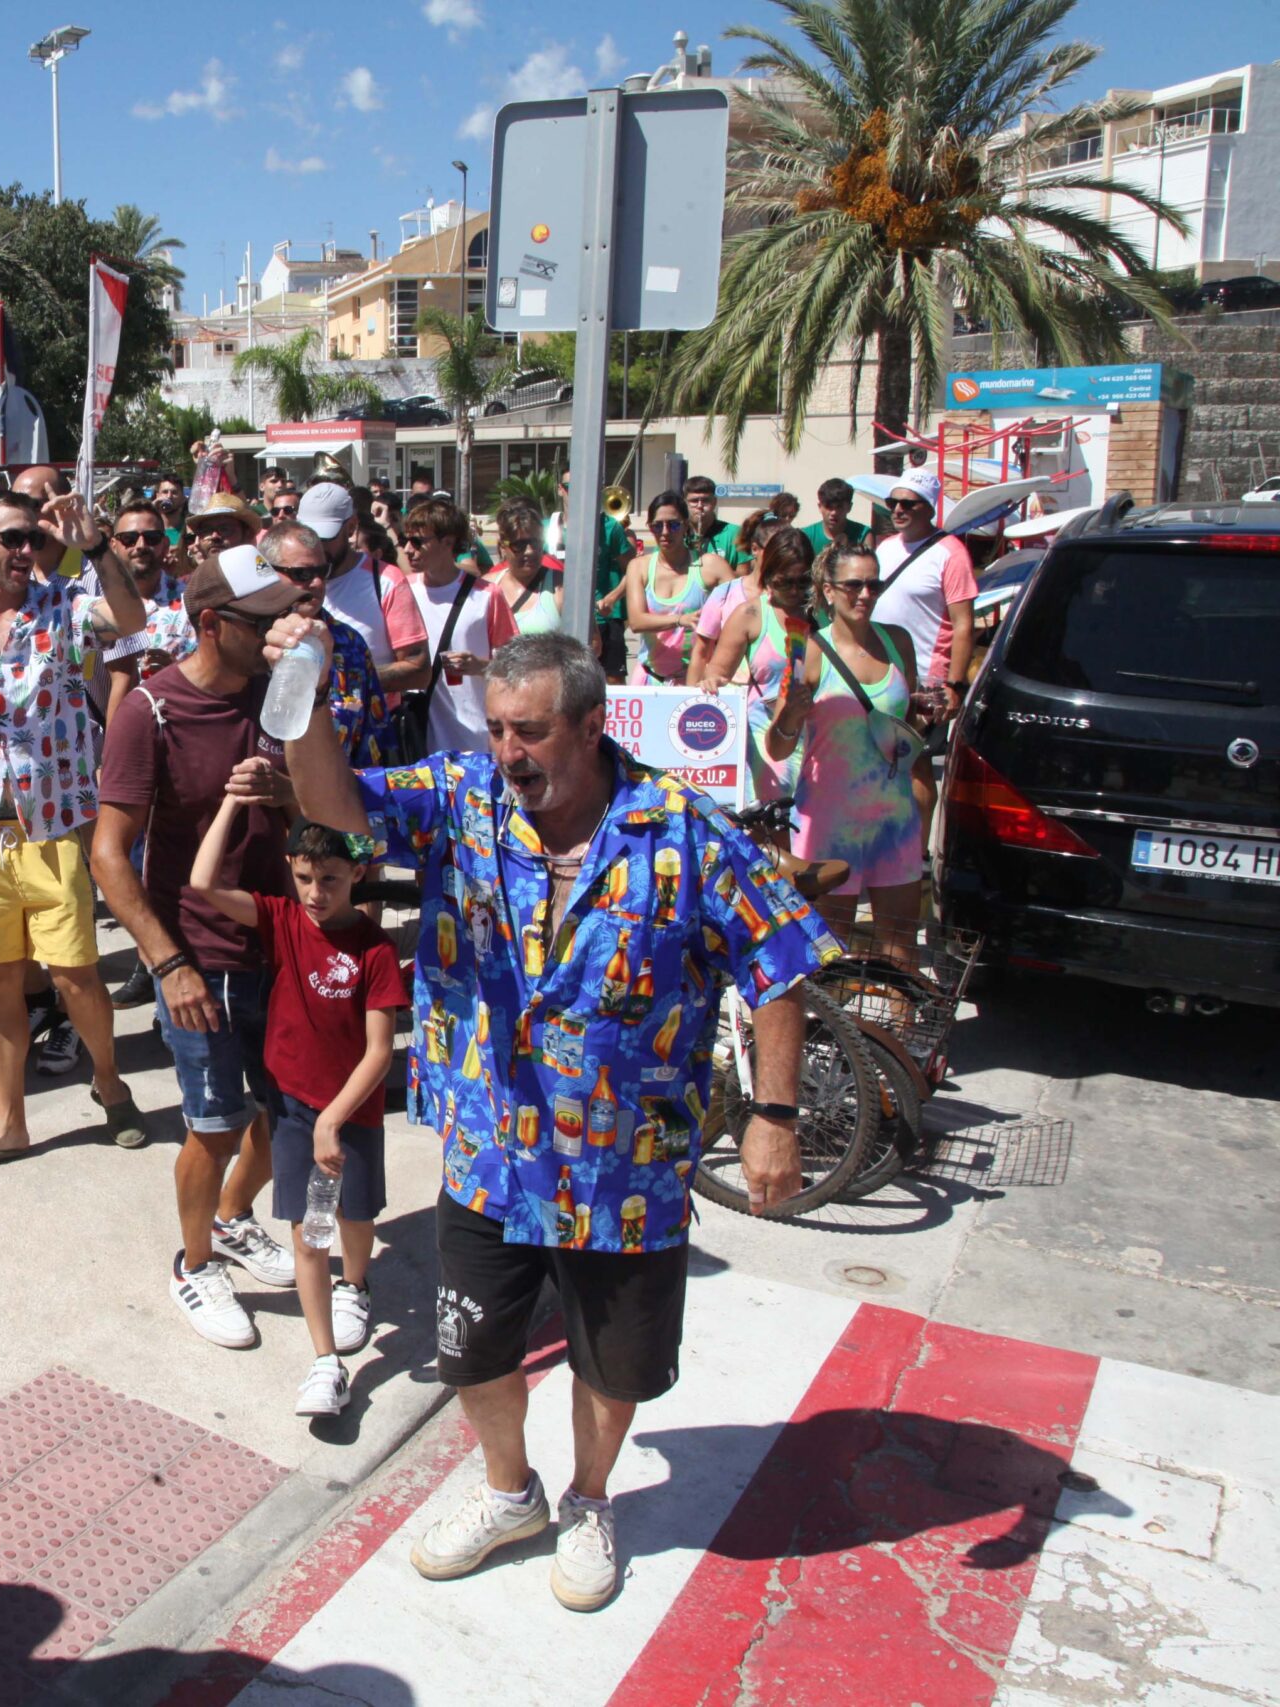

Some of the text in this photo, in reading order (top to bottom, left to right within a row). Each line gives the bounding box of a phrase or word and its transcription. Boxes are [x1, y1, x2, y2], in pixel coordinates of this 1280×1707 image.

[979, 377, 1035, 389] mundomarino
[1007, 711, 1090, 728] RODIUS
[605, 720, 643, 738] RTO
[1162, 837, 1241, 871] 1084
[461, 1296, 484, 1323] BUFA
